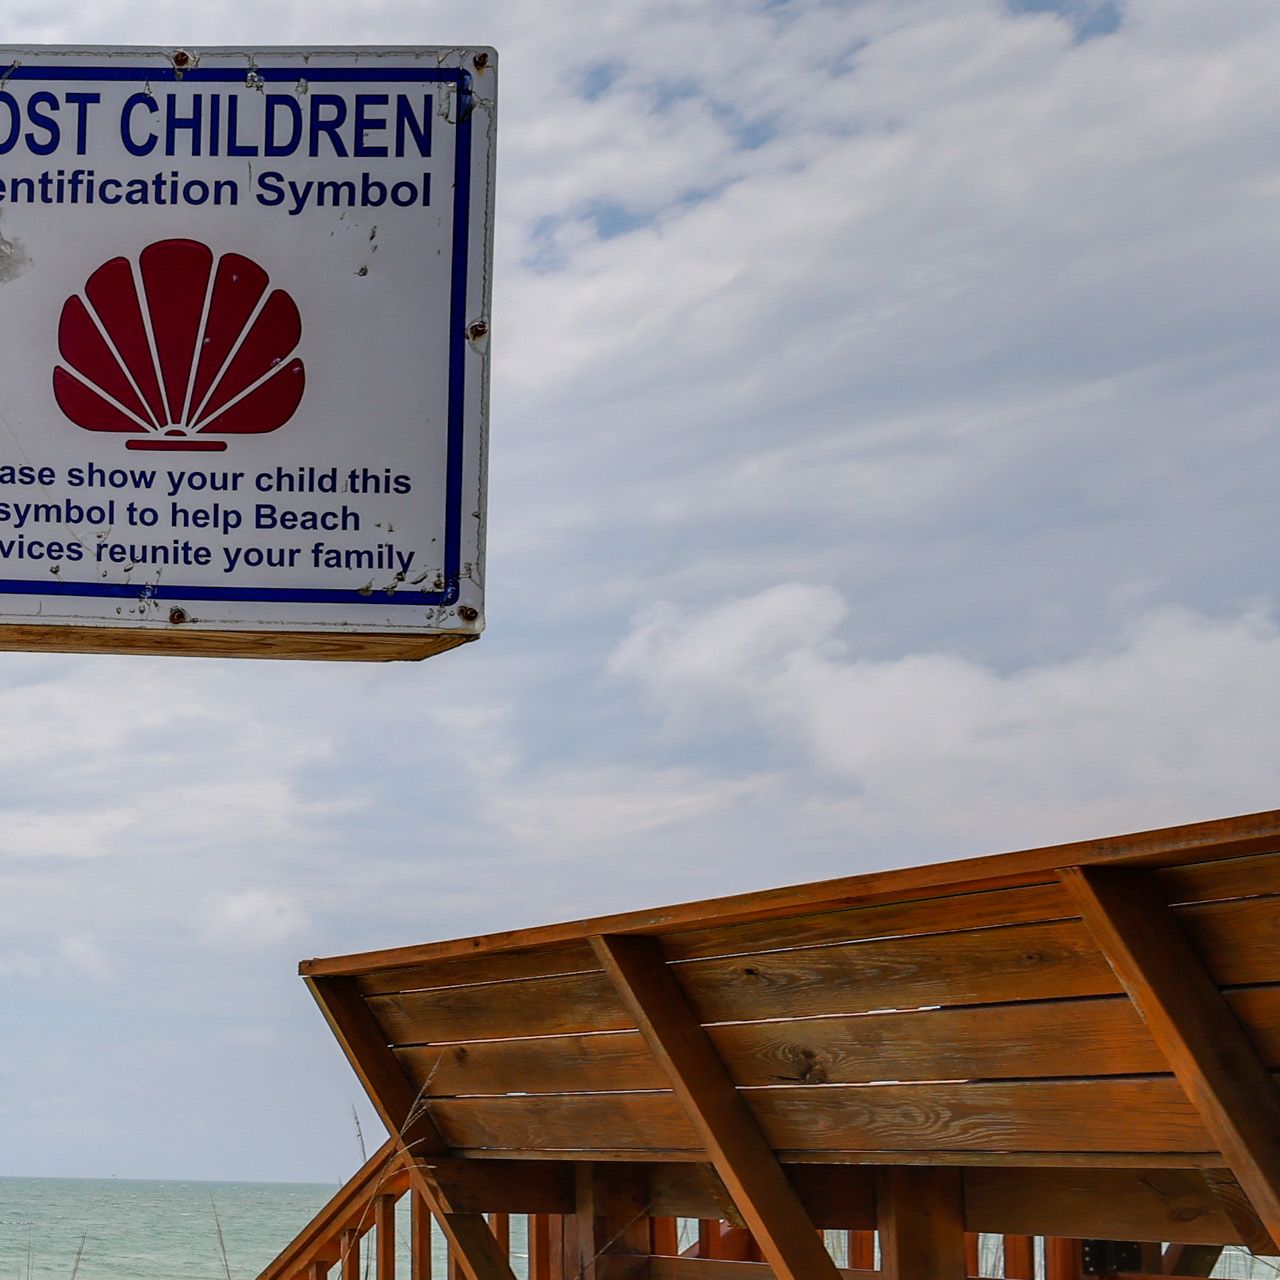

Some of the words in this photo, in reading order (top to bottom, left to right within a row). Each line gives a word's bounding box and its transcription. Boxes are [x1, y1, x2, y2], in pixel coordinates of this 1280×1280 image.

[120, 92, 434, 159] CHILDREN
[255, 171, 432, 216] Symbol
[67, 462, 158, 490] show
[167, 469, 245, 497] your
[255, 467, 338, 493] child
[348, 468, 413, 495] this
[126, 502, 159, 527] to
[171, 501, 242, 535] help
[255, 504, 361, 532] Beach
[96, 540, 212, 566] reunite
[222, 546, 302, 573] your
[311, 542, 415, 576] family
